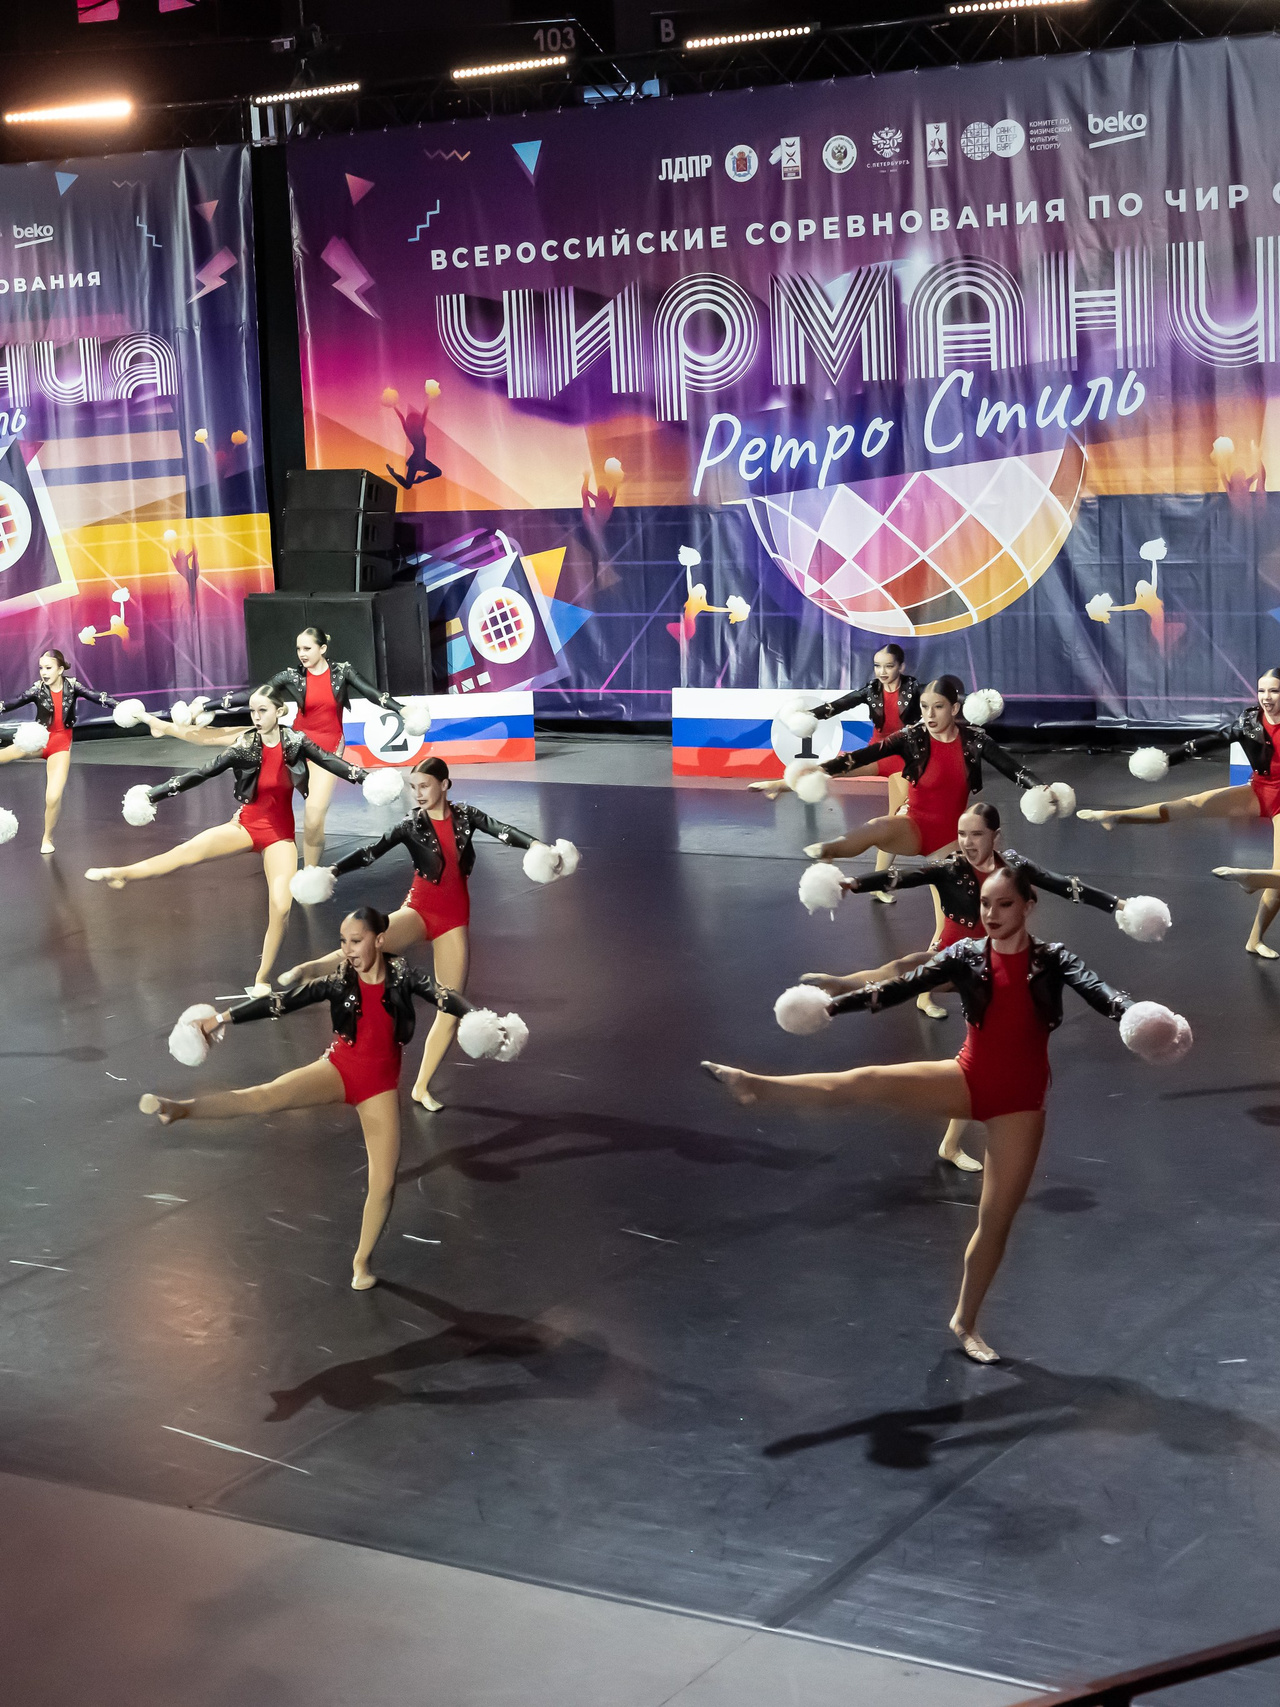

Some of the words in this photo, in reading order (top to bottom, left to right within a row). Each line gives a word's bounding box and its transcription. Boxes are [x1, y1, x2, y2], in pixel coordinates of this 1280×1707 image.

[533, 26, 577, 52] 103
[1029, 119, 1058, 128] КОМИТЕТ
[1059, 117, 1070, 125] ПО
[1029, 124, 1073, 135] ФИЗИЧЕСКОЙ
[1087, 110, 1148, 135] beko
[1029, 134, 1060, 144] КУЛЬТУРЕ
[1035, 142, 1061, 151] СПОРТУ
[658, 154, 713, 183] ЛДПР
[12, 223, 54, 239] beko
[430, 226, 728, 270] ВСЕРОССИЙСКИЕ
[745, 198, 1066, 245] СОРЕВНОВАНИЯ
[1088, 192, 1143, 220] ПО
[1164, 184, 1250, 213] ЧИР
[692, 412, 895, 497] Ретро
[923, 369, 1146, 454] Стиль
[379, 712, 409, 753] 2
